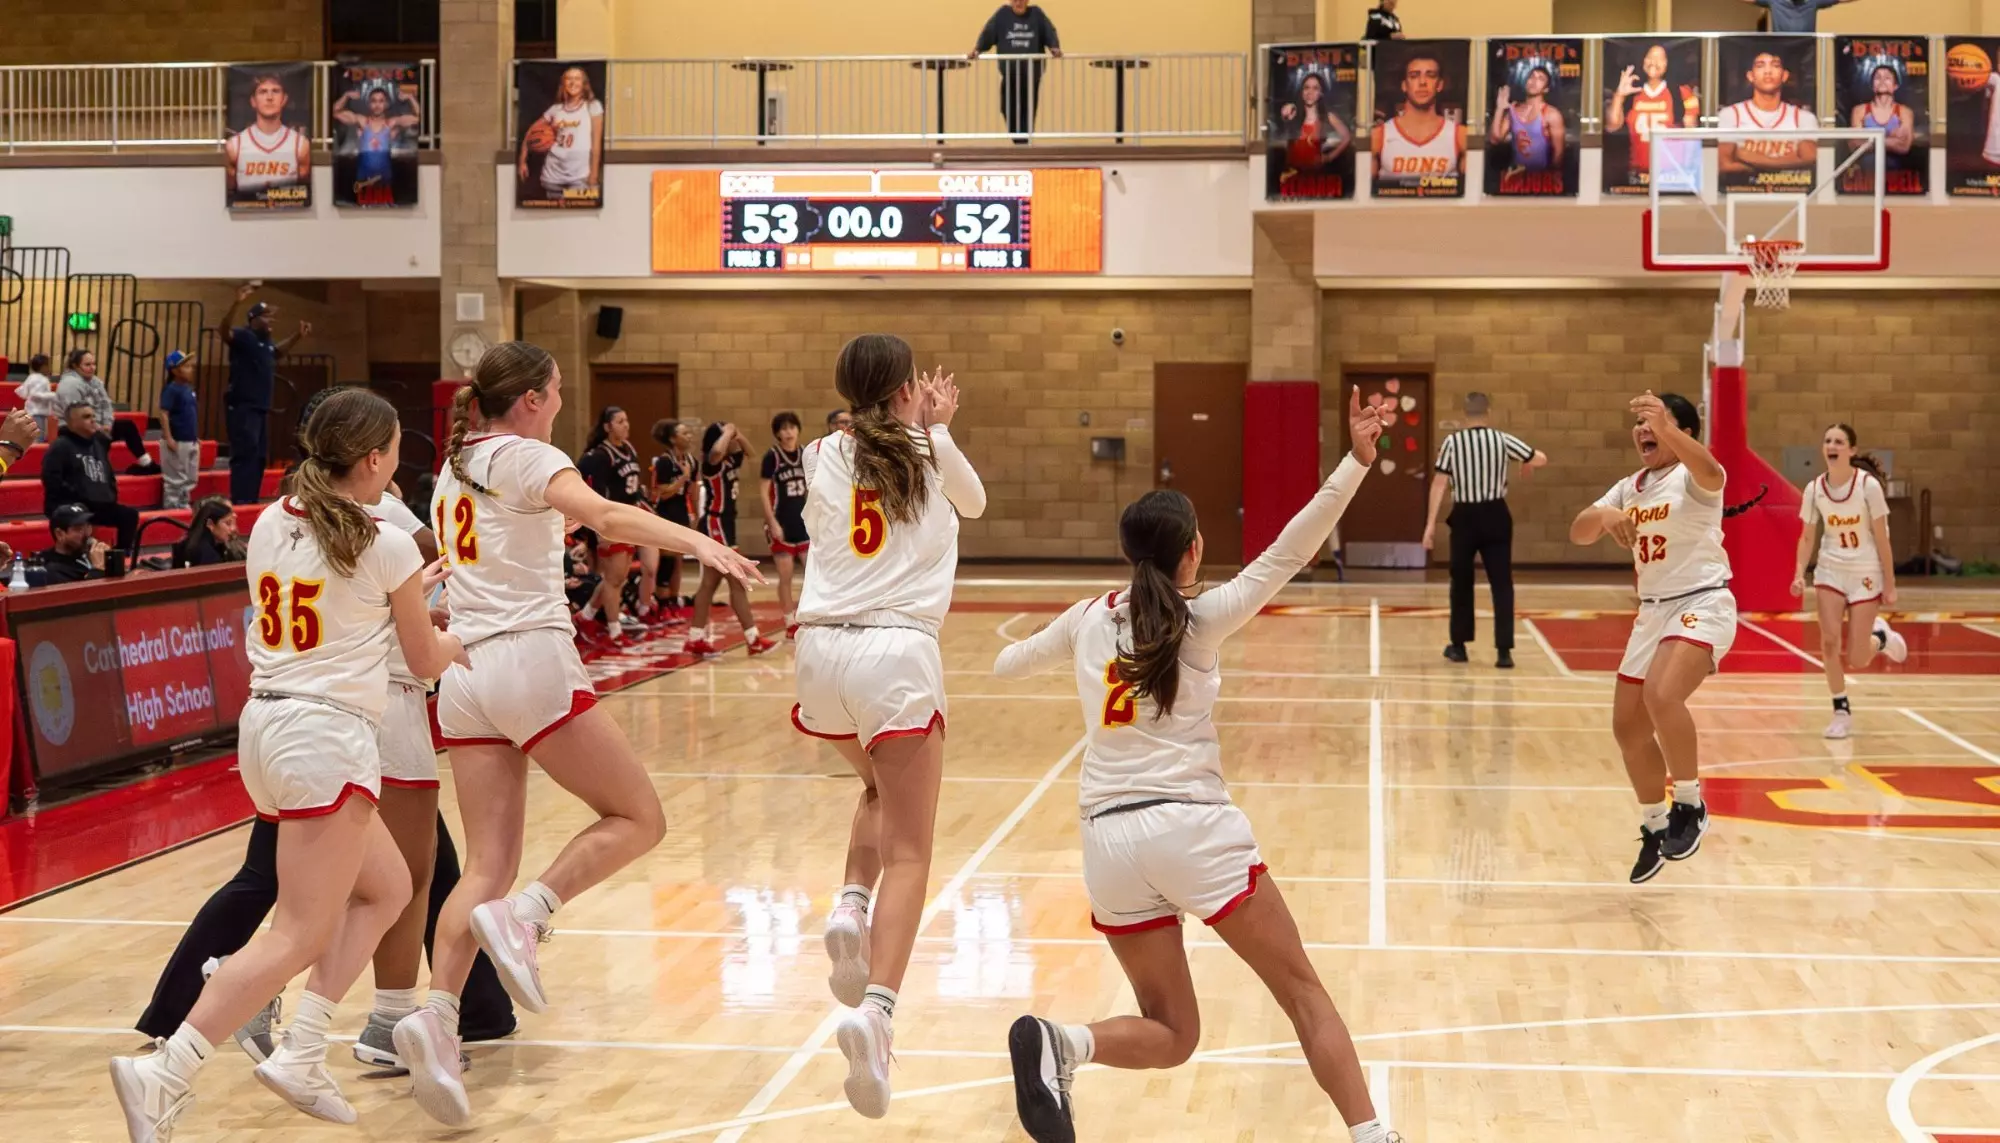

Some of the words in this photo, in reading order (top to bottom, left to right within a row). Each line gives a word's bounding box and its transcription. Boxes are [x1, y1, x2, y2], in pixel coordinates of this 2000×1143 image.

[245, 160, 292, 174] DONS
[938, 174, 980, 193] OAK
[980, 174, 1030, 193] HILLS
[1393, 156, 1449, 173] DONS
[741, 203, 799, 245] 53
[827, 204, 904, 238] 00.0
[953, 203, 1013, 245] 52
[436, 493, 481, 567] 12
[849, 484, 888, 560] 5
[1839, 530, 1860, 549] 10
[257, 570, 327, 656] 35
[83, 628, 168, 675] Cathedral
[169, 617, 235, 657] Catholic
[125, 687, 165, 731] High
[164, 678, 214, 717] School
[1101, 656, 1140, 729] 2
